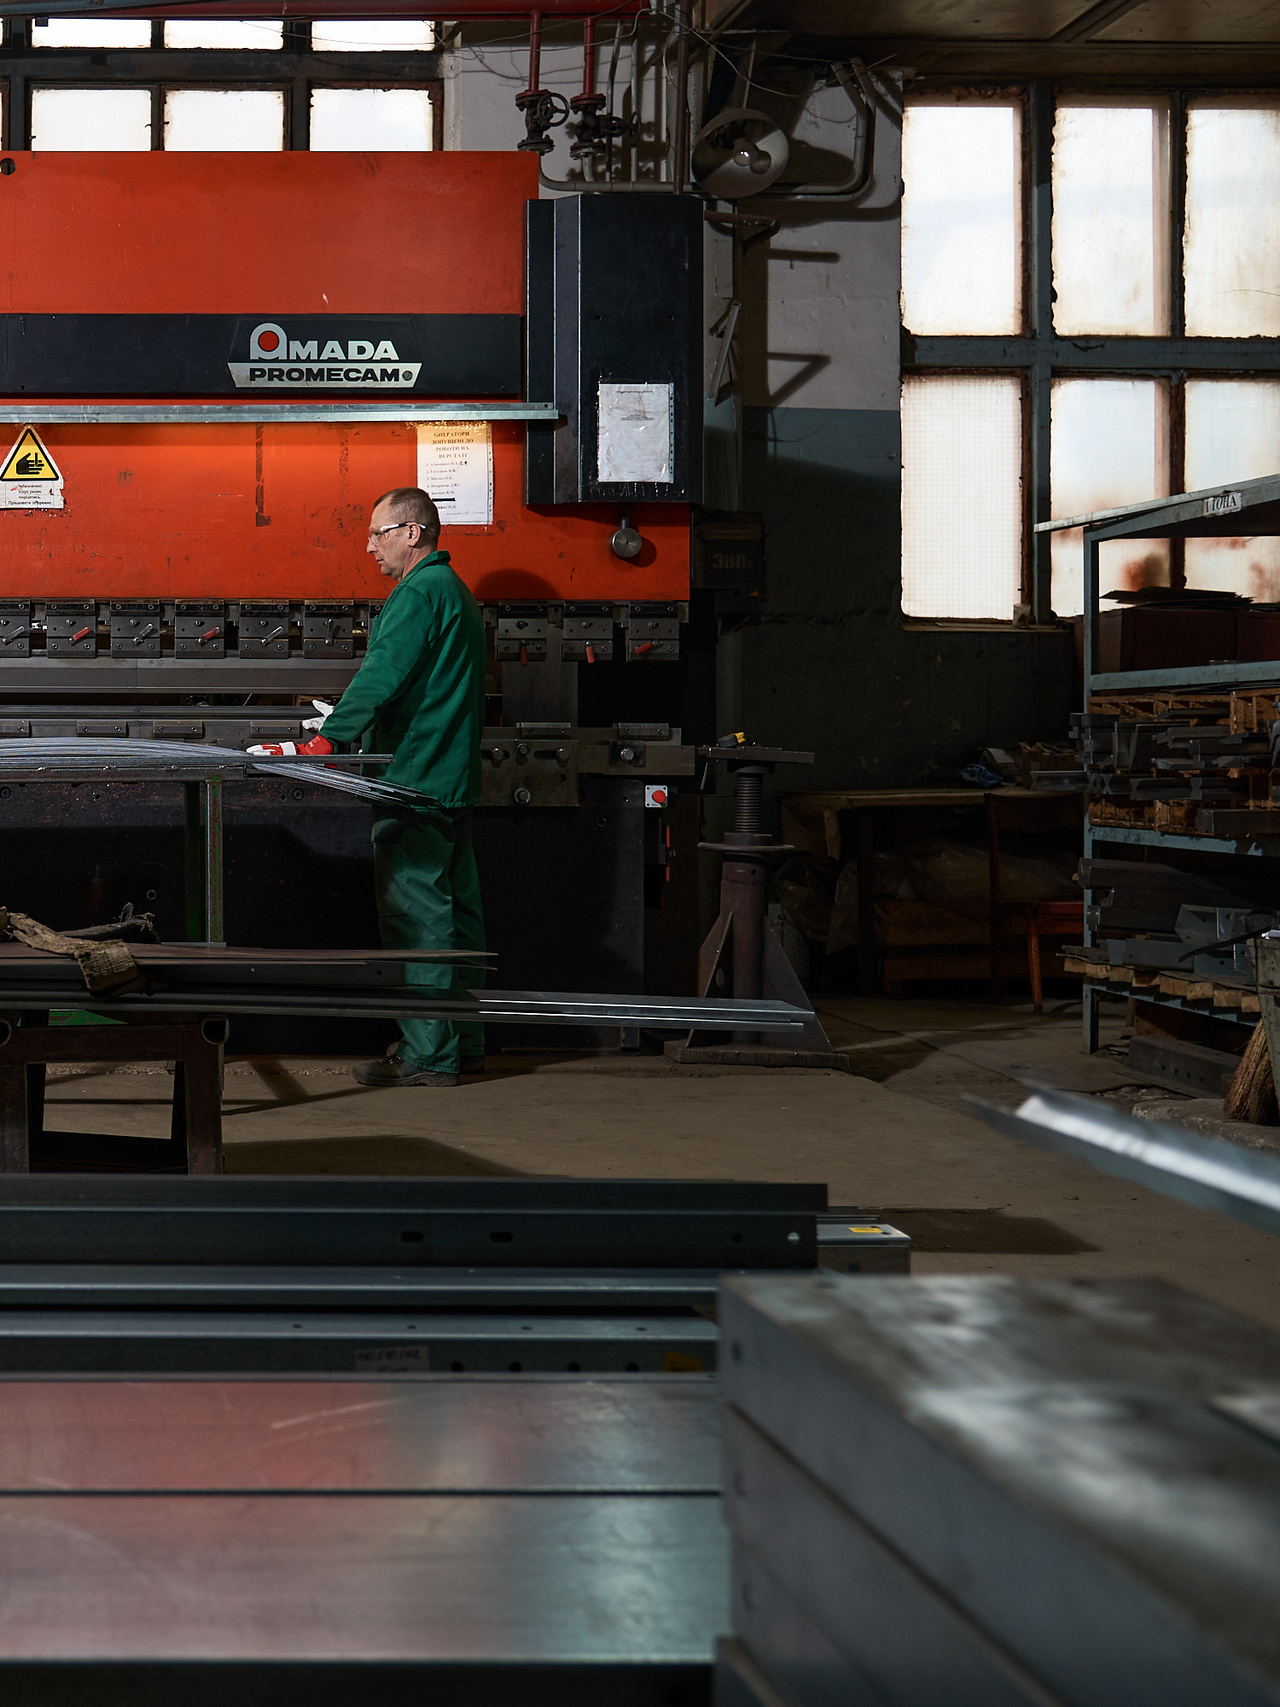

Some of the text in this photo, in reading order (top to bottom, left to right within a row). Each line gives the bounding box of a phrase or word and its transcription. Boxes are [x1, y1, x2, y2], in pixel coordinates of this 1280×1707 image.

[249, 322, 400, 361] AMADA
[249, 367, 400, 382] PROMECAM
[1212, 495, 1237, 511] ТОНА
